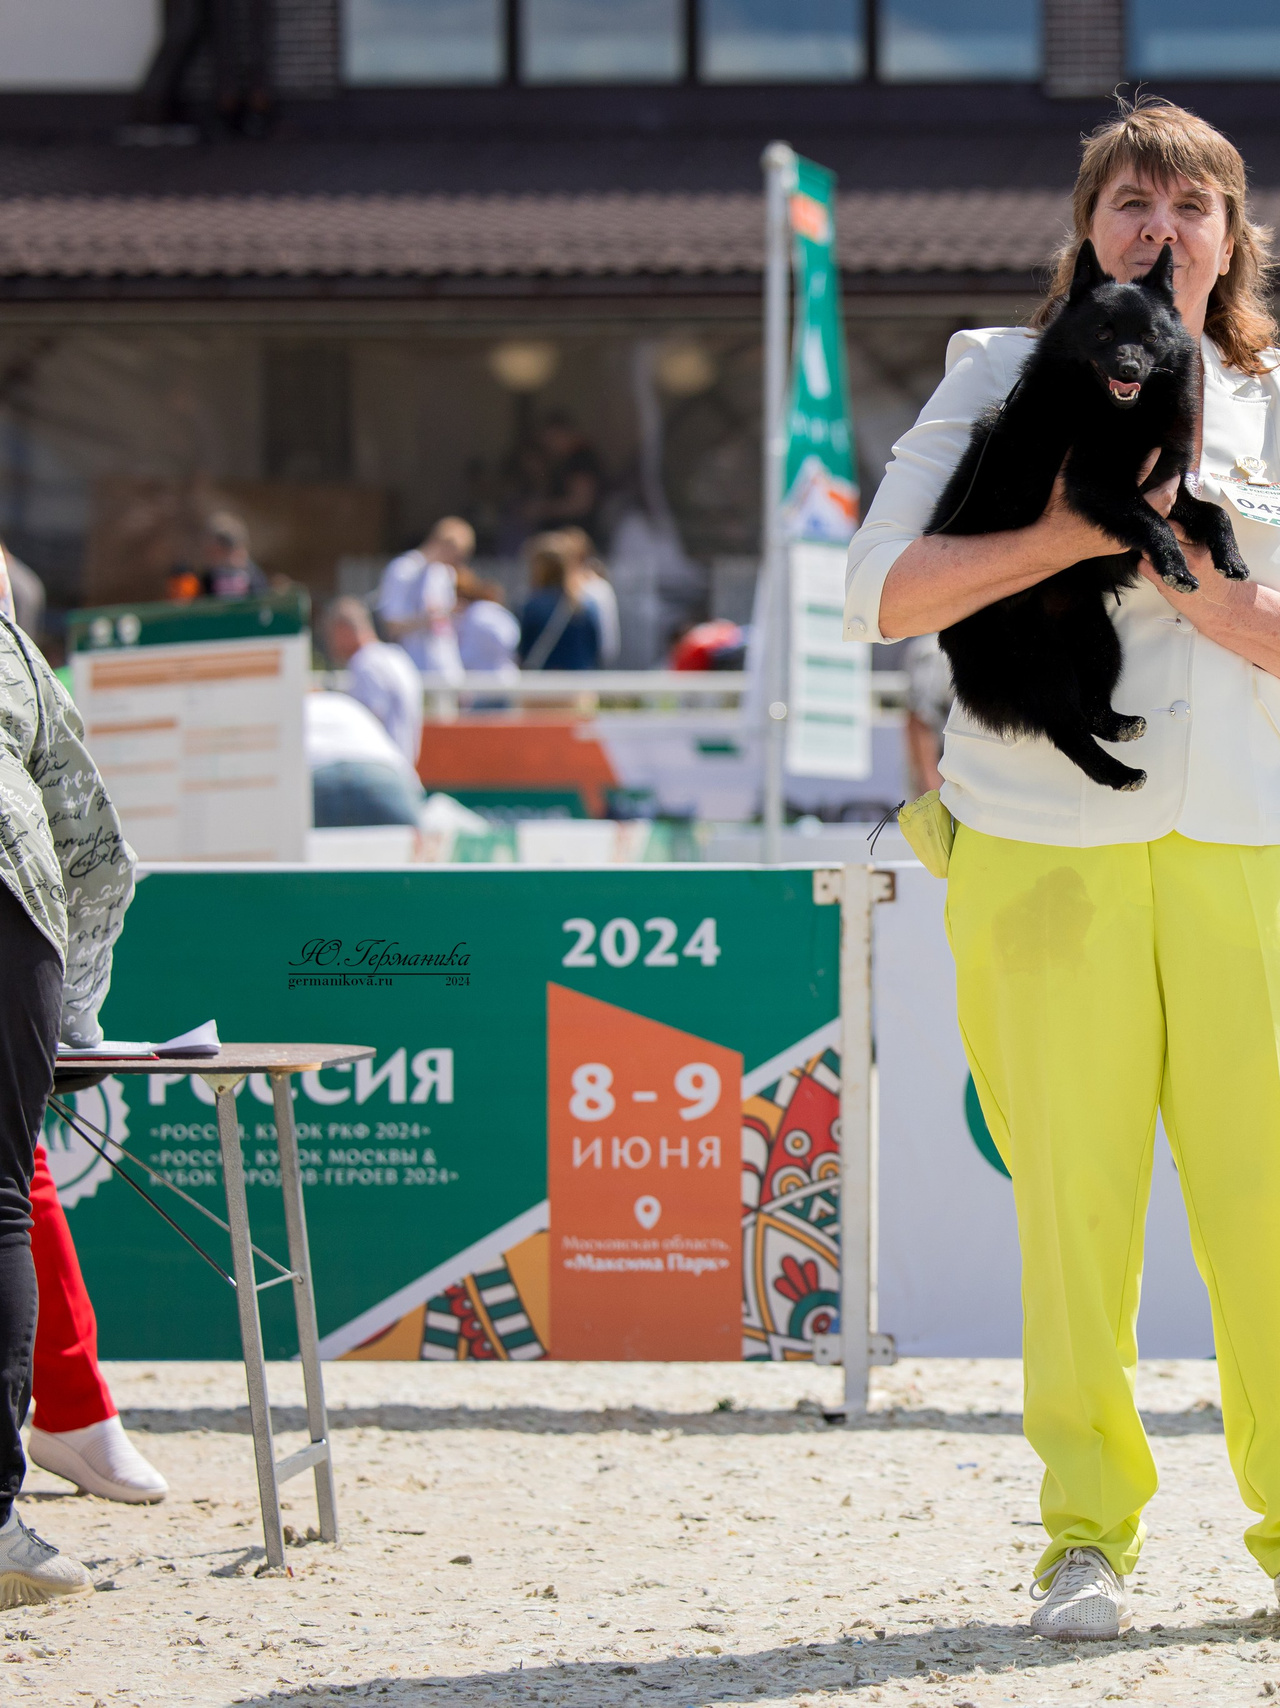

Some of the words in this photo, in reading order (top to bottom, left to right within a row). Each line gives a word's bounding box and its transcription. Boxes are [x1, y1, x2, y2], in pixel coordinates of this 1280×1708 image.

[562, 917, 722, 968] 2024
[327, 1122, 370, 1141] РКФ
[327, 1148, 418, 1166] МОСКВЫ
[421, 1147, 437, 1165] &
[572, 1135, 722, 1170] ИЮНЯ
